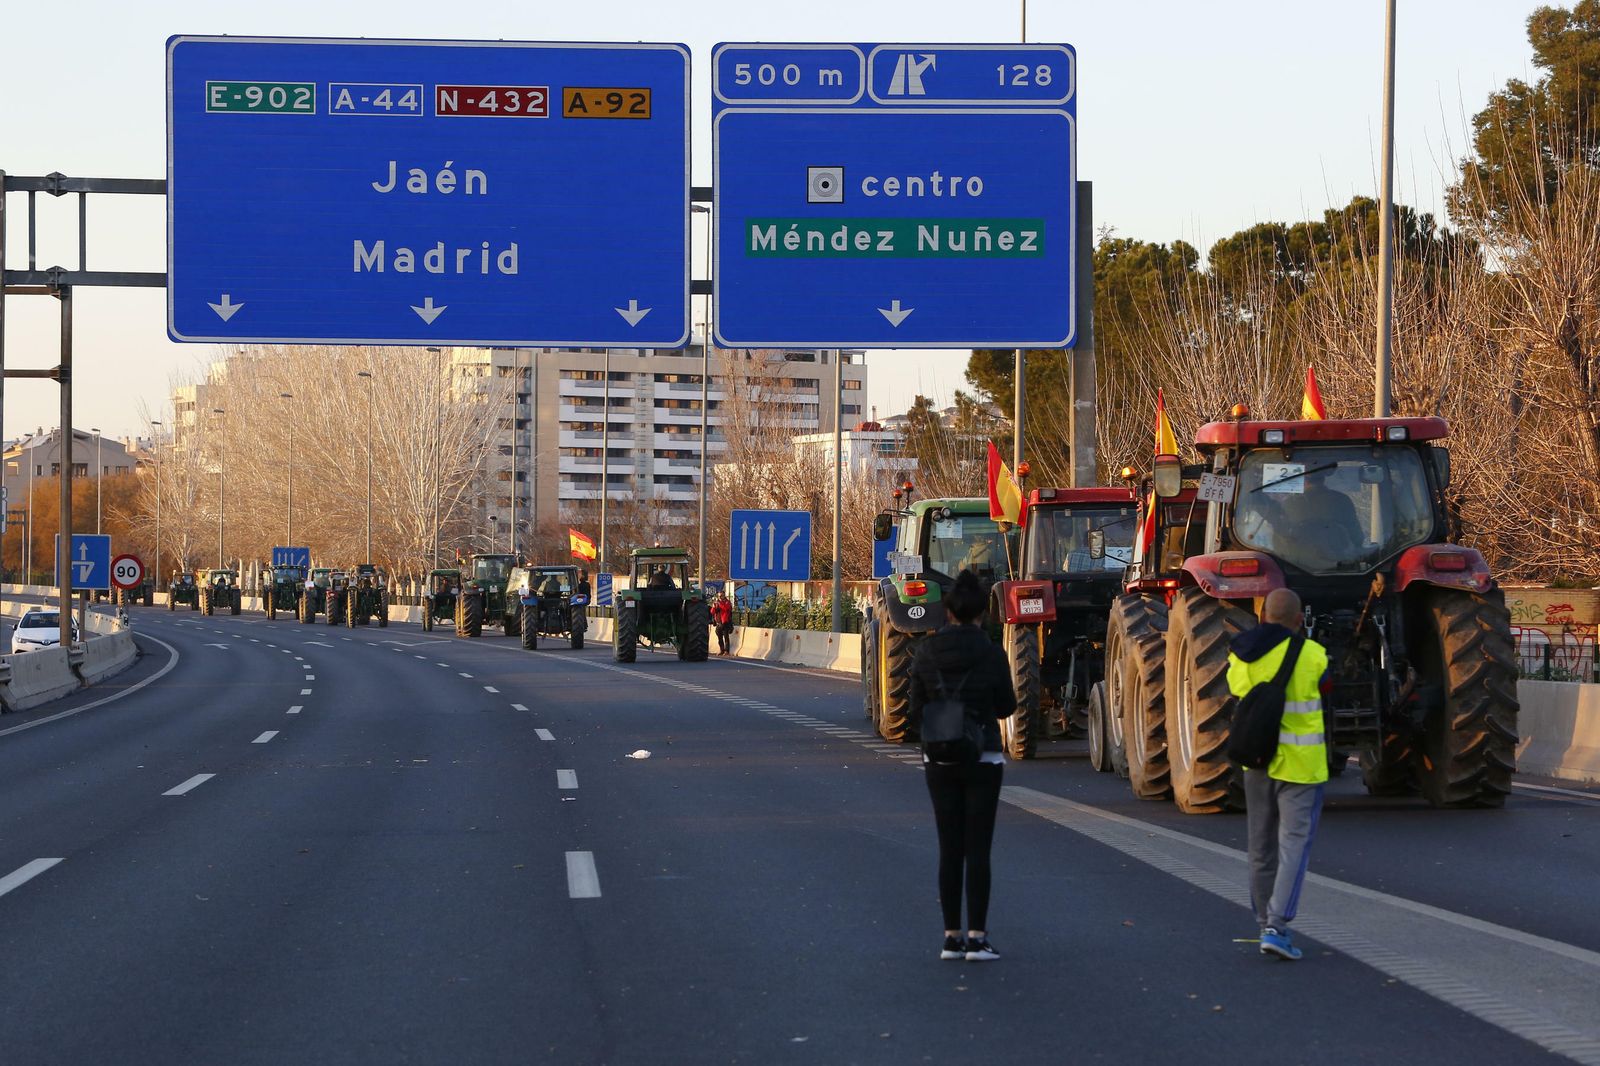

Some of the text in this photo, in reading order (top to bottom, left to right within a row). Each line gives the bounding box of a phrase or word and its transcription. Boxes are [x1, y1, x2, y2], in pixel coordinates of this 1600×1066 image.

[734, 63, 843, 86] 500 m
[996, 64, 1052, 87] 128
[209, 86, 312, 111] E-902
[334, 88, 419, 112] A-44
[439, 89, 545, 114] N-432
[567, 91, 647, 115] A-92
[371, 160, 488, 195] Jaén
[860, 170, 985, 198] centro
[751, 224, 1039, 252] Méndez Nuñez
[353, 239, 519, 275] Madrid
[1280, 467, 1289, 478] 2
[1116, 549, 1124, 558] 2
[116, 566, 137, 578] 90
[911, 607, 923, 617] 40
